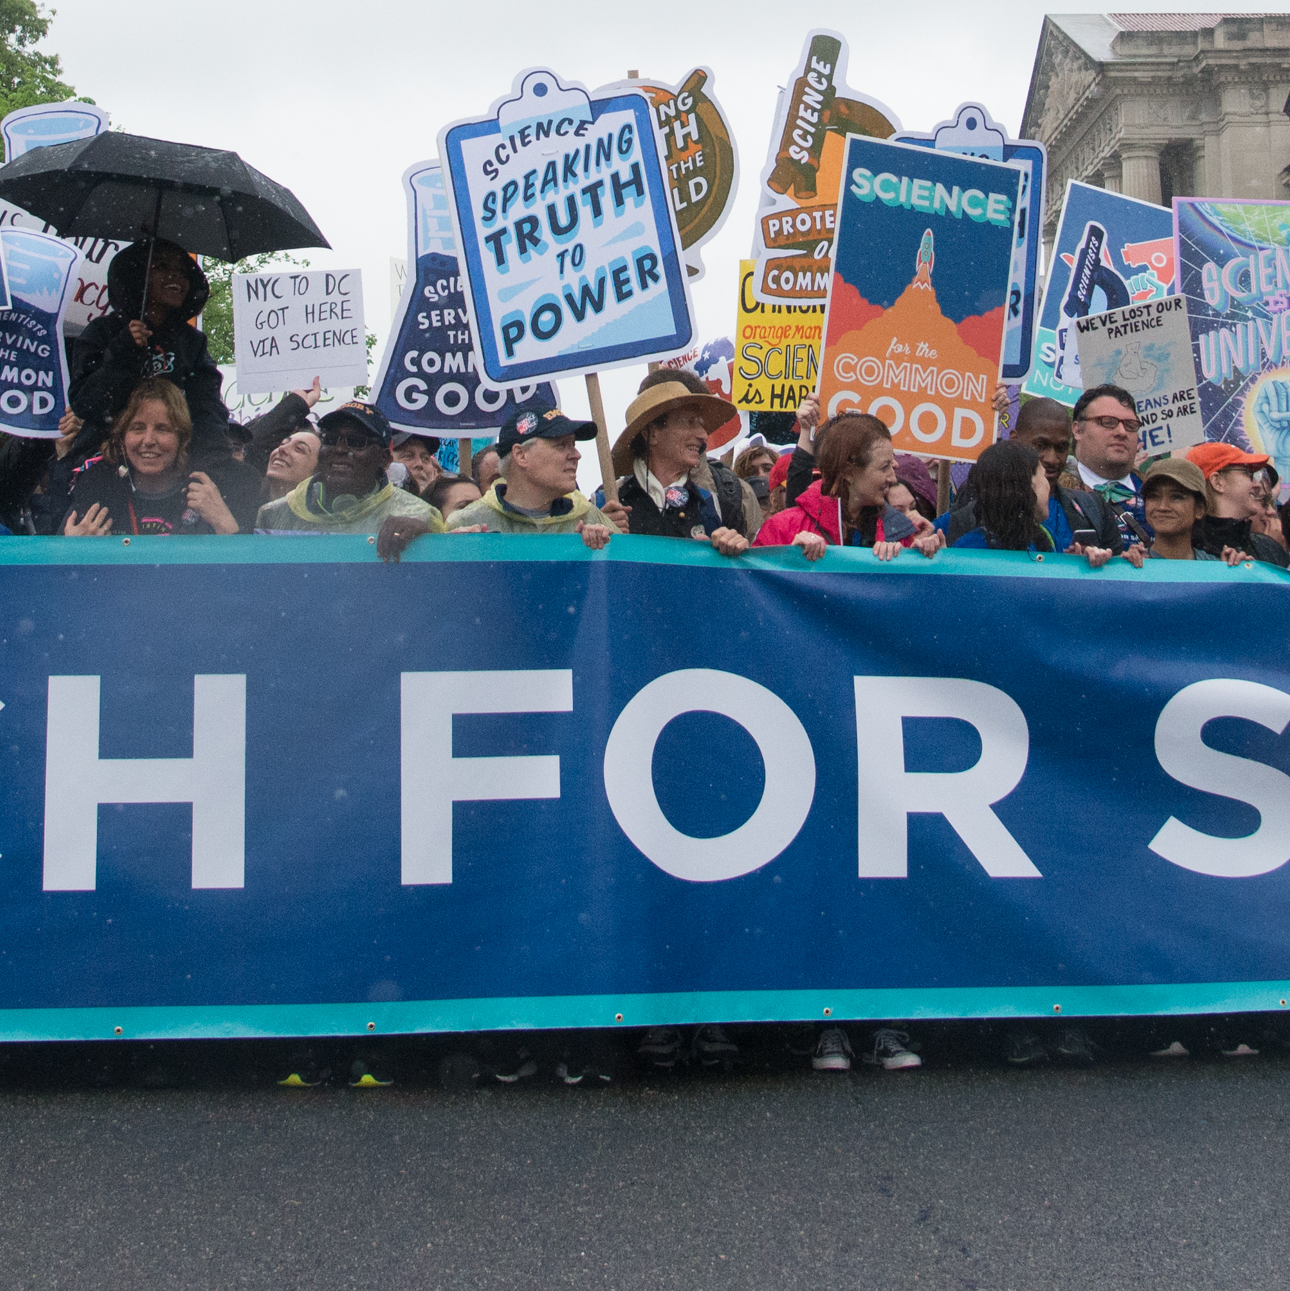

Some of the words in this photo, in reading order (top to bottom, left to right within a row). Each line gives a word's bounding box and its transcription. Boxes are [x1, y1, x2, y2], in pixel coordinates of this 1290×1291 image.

[788, 56, 831, 164] SCIENCE
[482, 117, 594, 181] SCIENCE
[481, 122, 635, 225] SPEAKING
[669, 151, 705, 179] THE
[850, 167, 1009, 222] SCIENCE
[484, 161, 646, 268] TRUTH
[768, 209, 835, 239] PROTE
[557, 242, 586, 276] TO
[1077, 236, 1099, 302] SCIENTISTS
[246, 277, 283, 303] NYC
[290, 274, 309, 296] TO
[325, 273, 350, 296] DC
[1264, 289, 1290, 312] IS
[255, 306, 289, 330] GOT
[305, 300, 353, 324] HERE
[417, 309, 470, 329] SERV
[501, 251, 661, 359] POWER
[1076, 313, 1118, 333] WE'VE
[1122, 304, 1152, 322] LOST
[1156, 297, 1183, 313] OUR
[448, 331, 469, 344] TH
[742, 325, 791, 347] orange
[1107, 316, 1163, 339] PATIENCE
[250, 336, 280, 358] VIA
[290, 328, 359, 351] SCIENCE
[886, 336, 911, 358] for
[915, 341, 938, 359] the
[404, 351, 478, 374] COMM
[739, 342, 820, 380] SCIEN
[834, 353, 987, 403] COMMON
[738, 383, 765, 404] is
[770, 384, 816, 409] HAR
[1136, 394, 1170, 413] EANS
[1172, 388, 1195, 404] ARE
[1161, 409, 1174, 421] SO
[1176, 402, 1197, 417] ARE
[400, 669, 1042, 885] FOR
